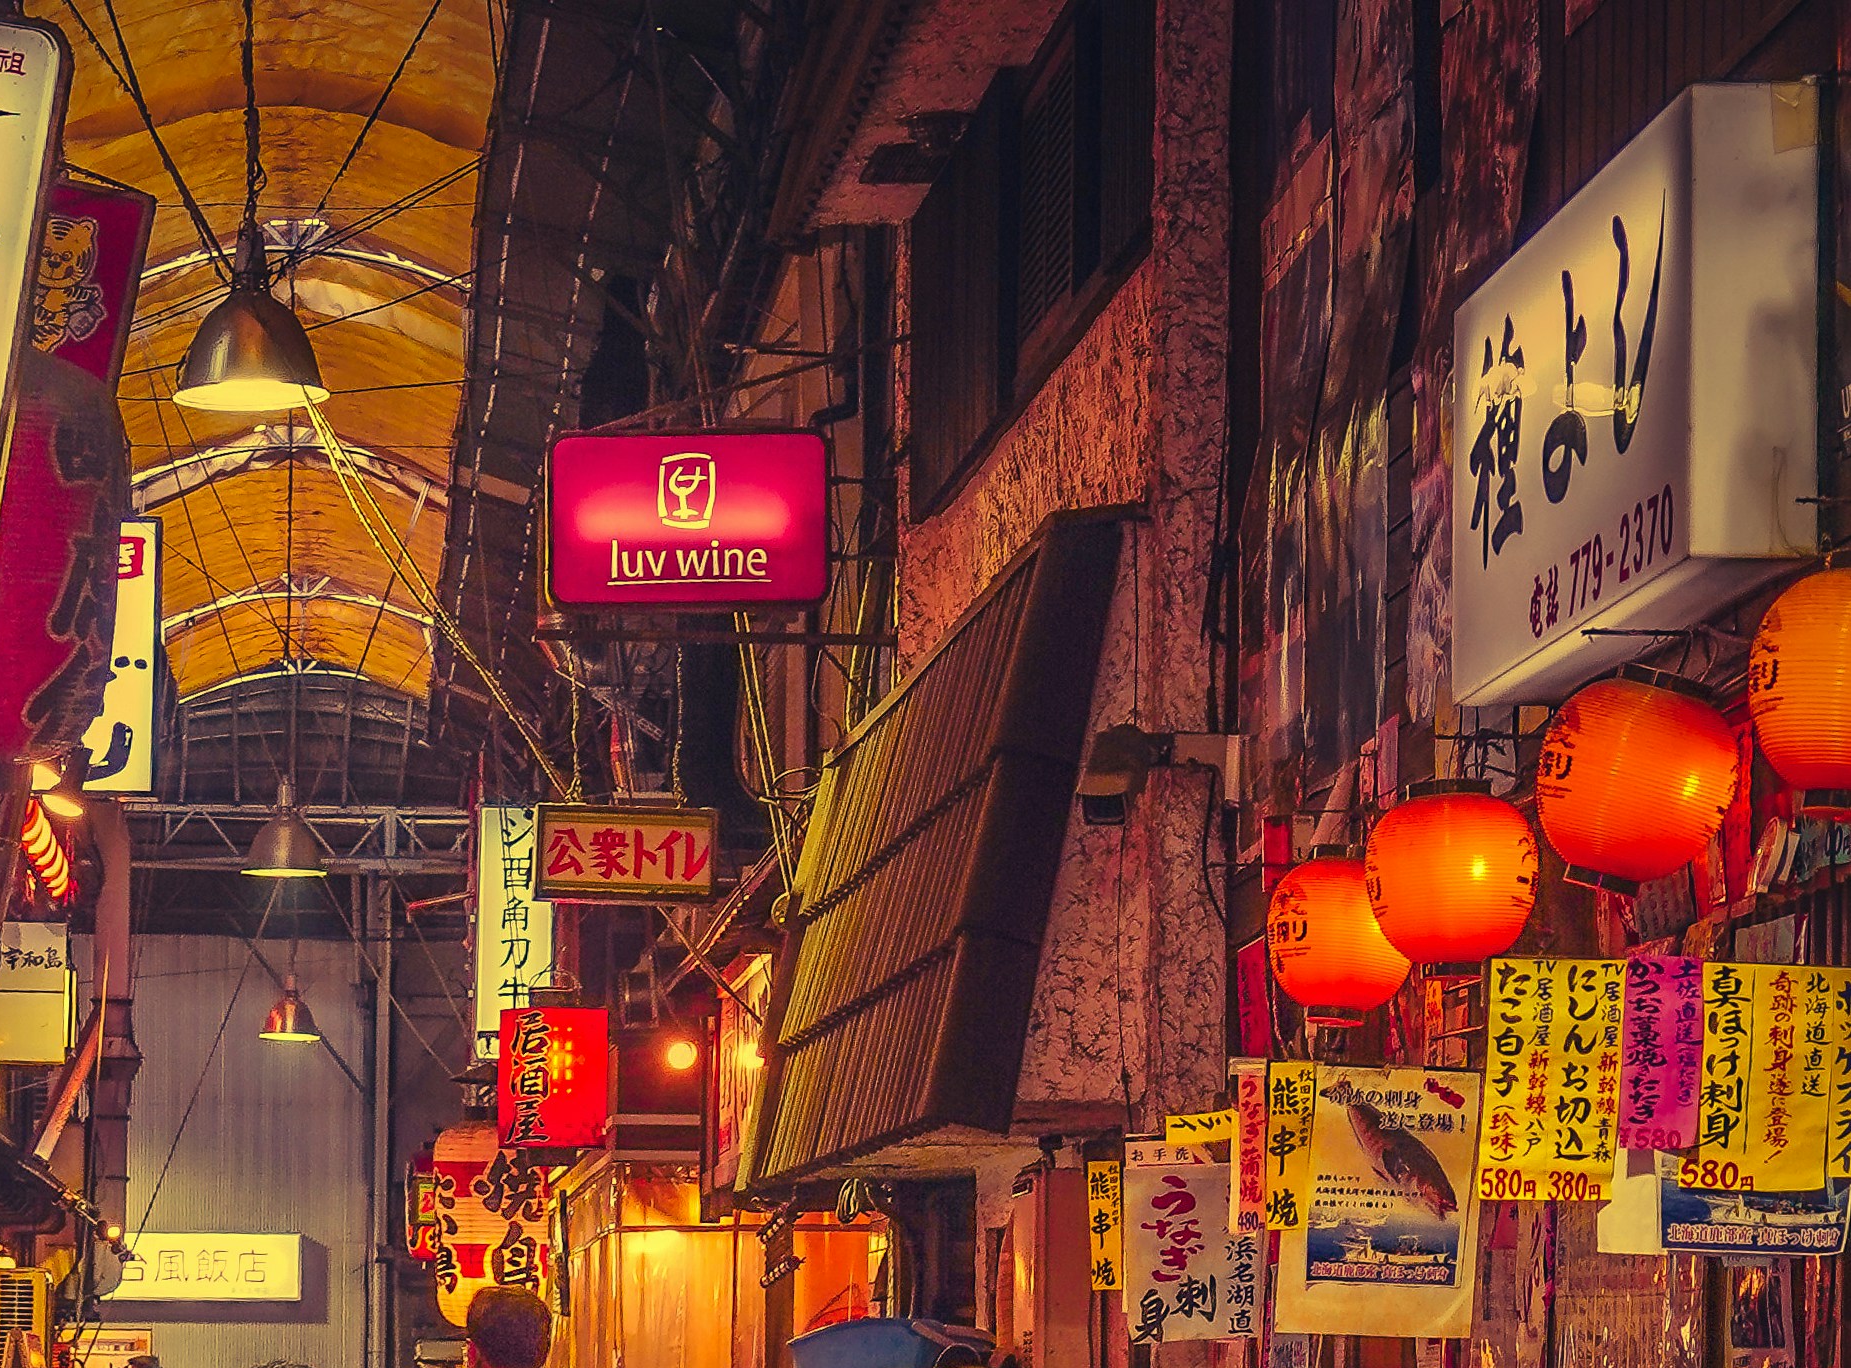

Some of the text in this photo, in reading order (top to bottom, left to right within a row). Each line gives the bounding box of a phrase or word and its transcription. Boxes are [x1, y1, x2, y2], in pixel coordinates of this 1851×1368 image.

[610, 539, 768, 580] luv wine
[1568, 484, 1676, 619] 779-2370
[546, 826, 710, 882] 公衆トイレ
[504, 1009, 551, 1145] 居酒屋
[1552, 964, 1599, 1161] にしんお切込
[1699, 965, 1752, 1150] 真ほっけ刺身
[1800, 972, 1833, 1099] 北海道直送
[1265, 1075, 1300, 1228] 熊串焼
[1481, 1167, 1537, 1200] 580円
[1548, 1169, 1602, 1202] 380円
[1679, 1159, 1755, 1191] 580円
[1089, 1171, 1117, 1287] 熊串焼
